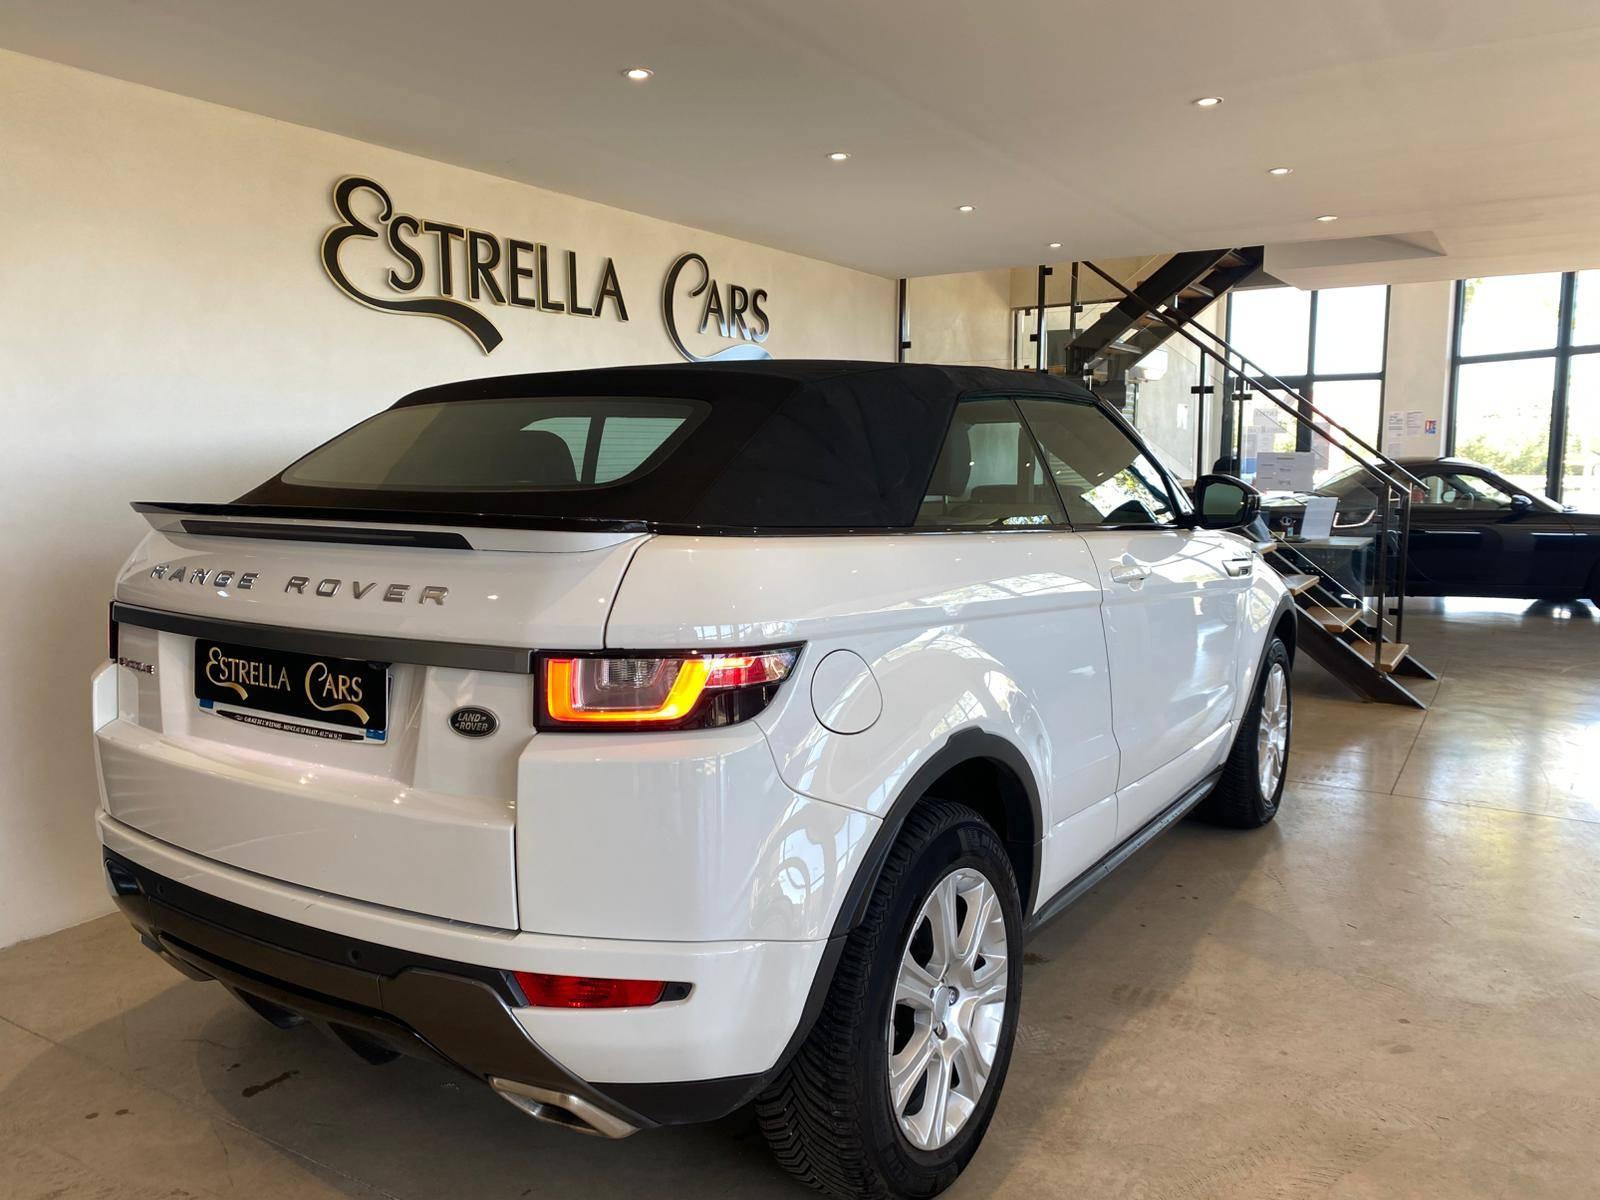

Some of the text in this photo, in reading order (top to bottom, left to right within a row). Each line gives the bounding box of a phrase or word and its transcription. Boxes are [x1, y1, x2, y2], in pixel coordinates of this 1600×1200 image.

[320, 175, 773, 361] ESTRELLA CARS
[150, 565, 449, 606] RANGE ROVER
[206, 647, 370, 724] ESTRELLA CARS
